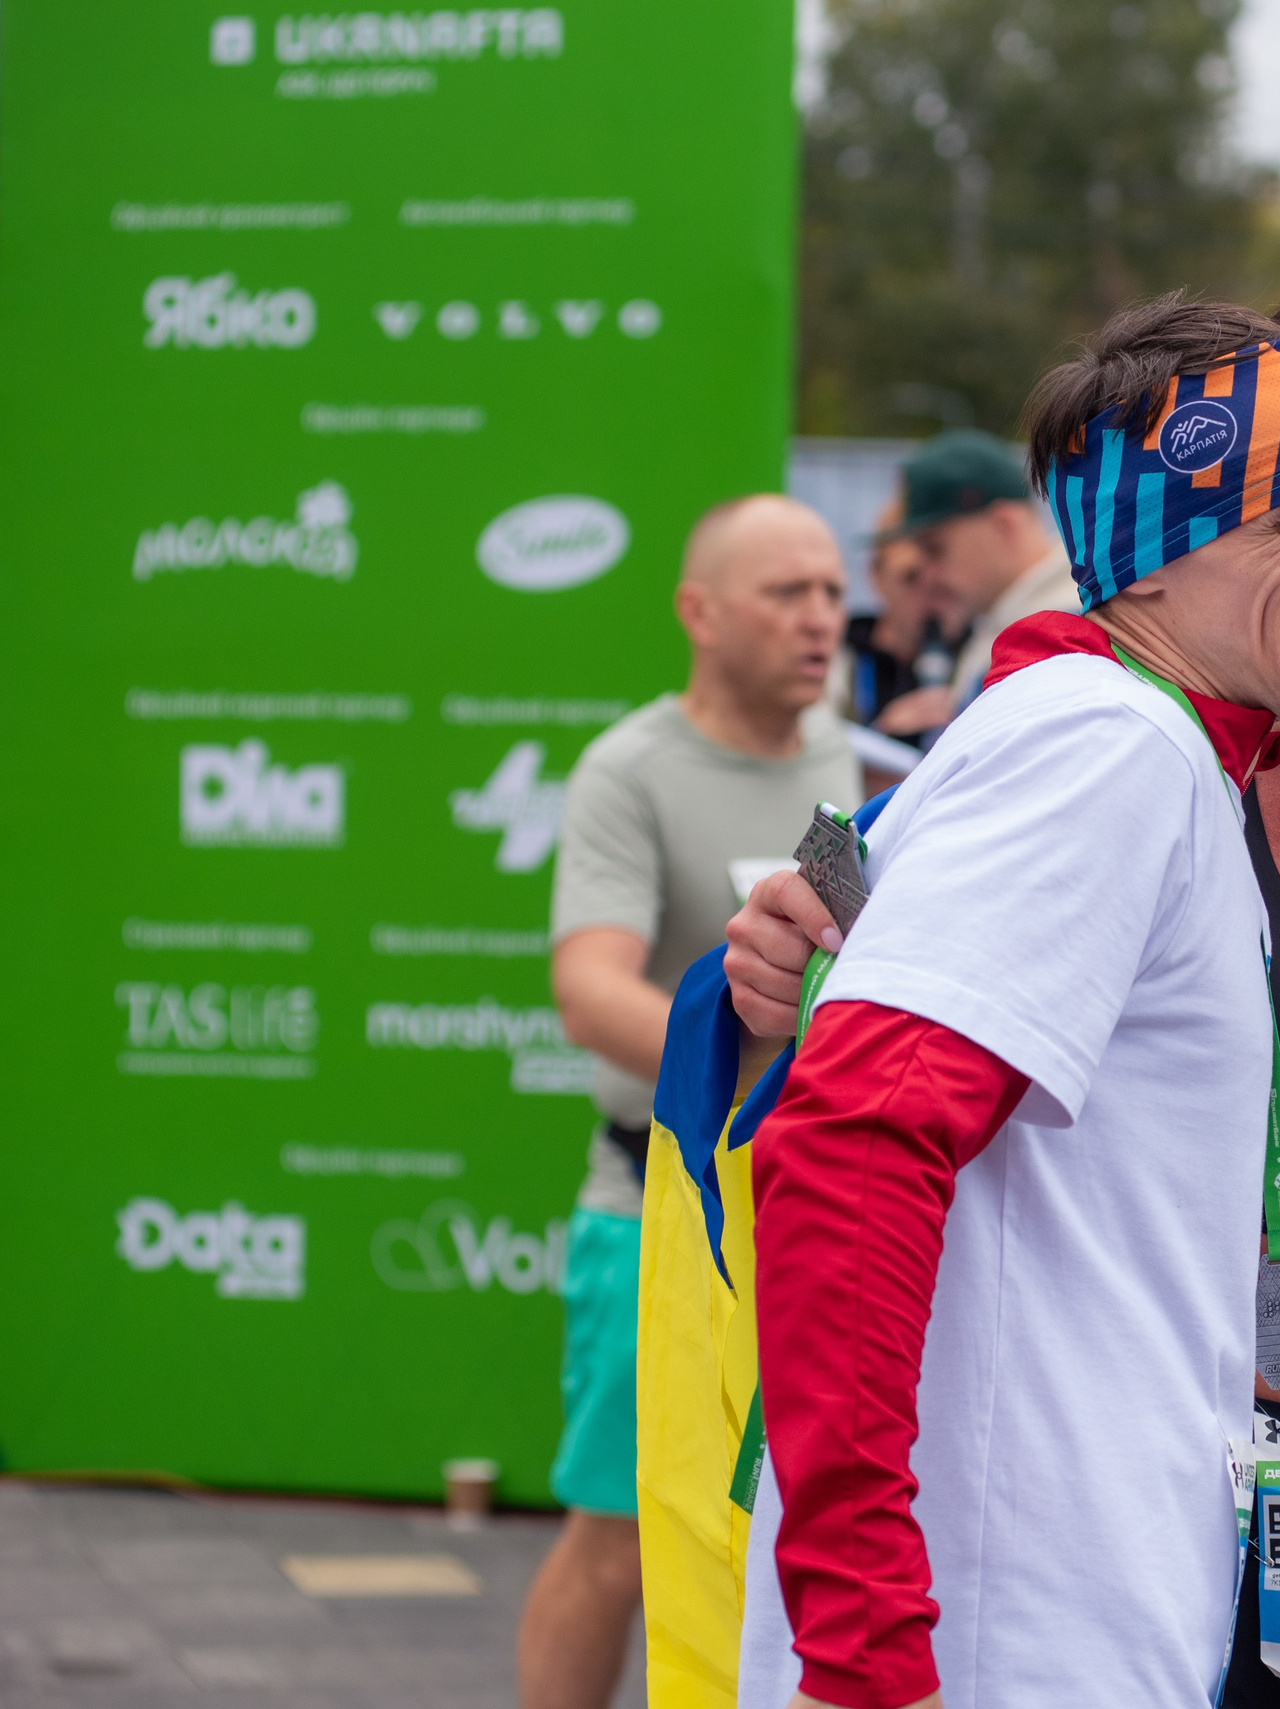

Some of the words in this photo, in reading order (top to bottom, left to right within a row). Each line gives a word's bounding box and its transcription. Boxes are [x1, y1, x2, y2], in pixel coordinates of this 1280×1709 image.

[277, 10, 562, 61] UKRNAFTA
[375, 300, 661, 341] VOLVO
[1176, 429, 1228, 461] КАРПАТІЯ
[118, 984, 225, 1049] TAS
[369, 1001, 571, 1053] morshyn
[118, 1199, 303, 1270] Data
[453, 1217, 564, 1291] Vol
[753, 1457, 761, 1476] RUN
[744, 1477, 758, 1510] UKRAINE
